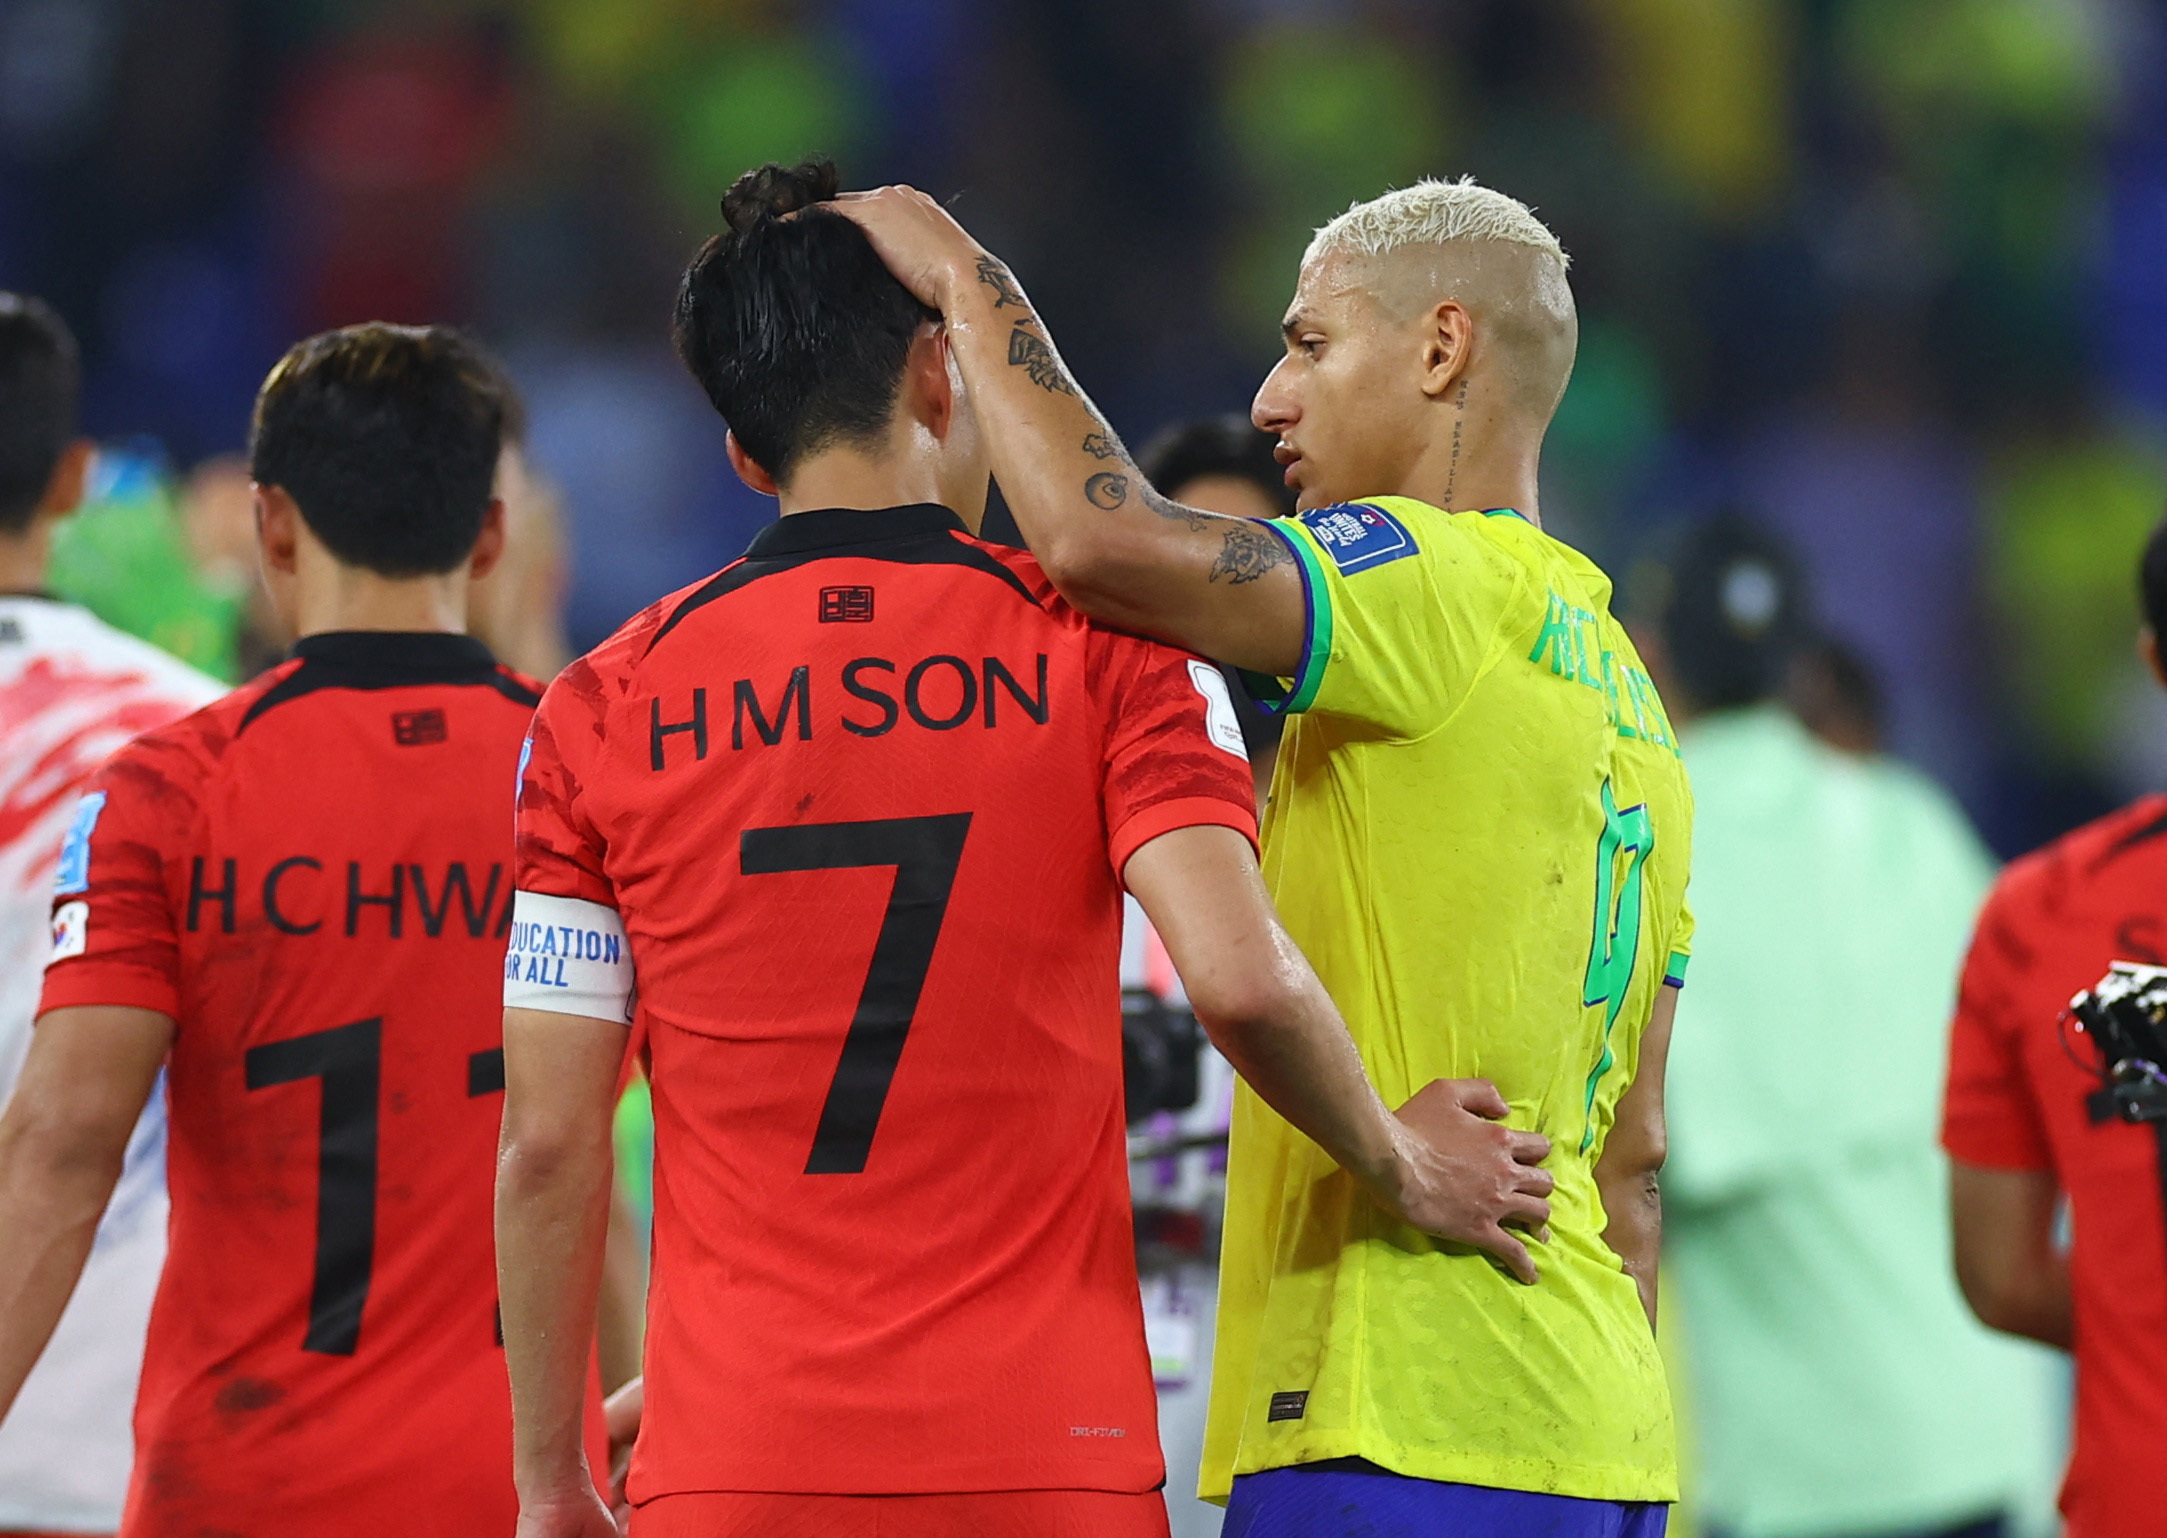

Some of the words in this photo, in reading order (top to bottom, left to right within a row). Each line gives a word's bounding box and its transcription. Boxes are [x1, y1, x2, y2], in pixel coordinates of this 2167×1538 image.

[841, 653, 1049, 738] SON
[186, 856, 236, 933] H
[262, 856, 323, 937] C
[525, 956, 568, 987] ALL
[740, 811, 974, 1174] 7
